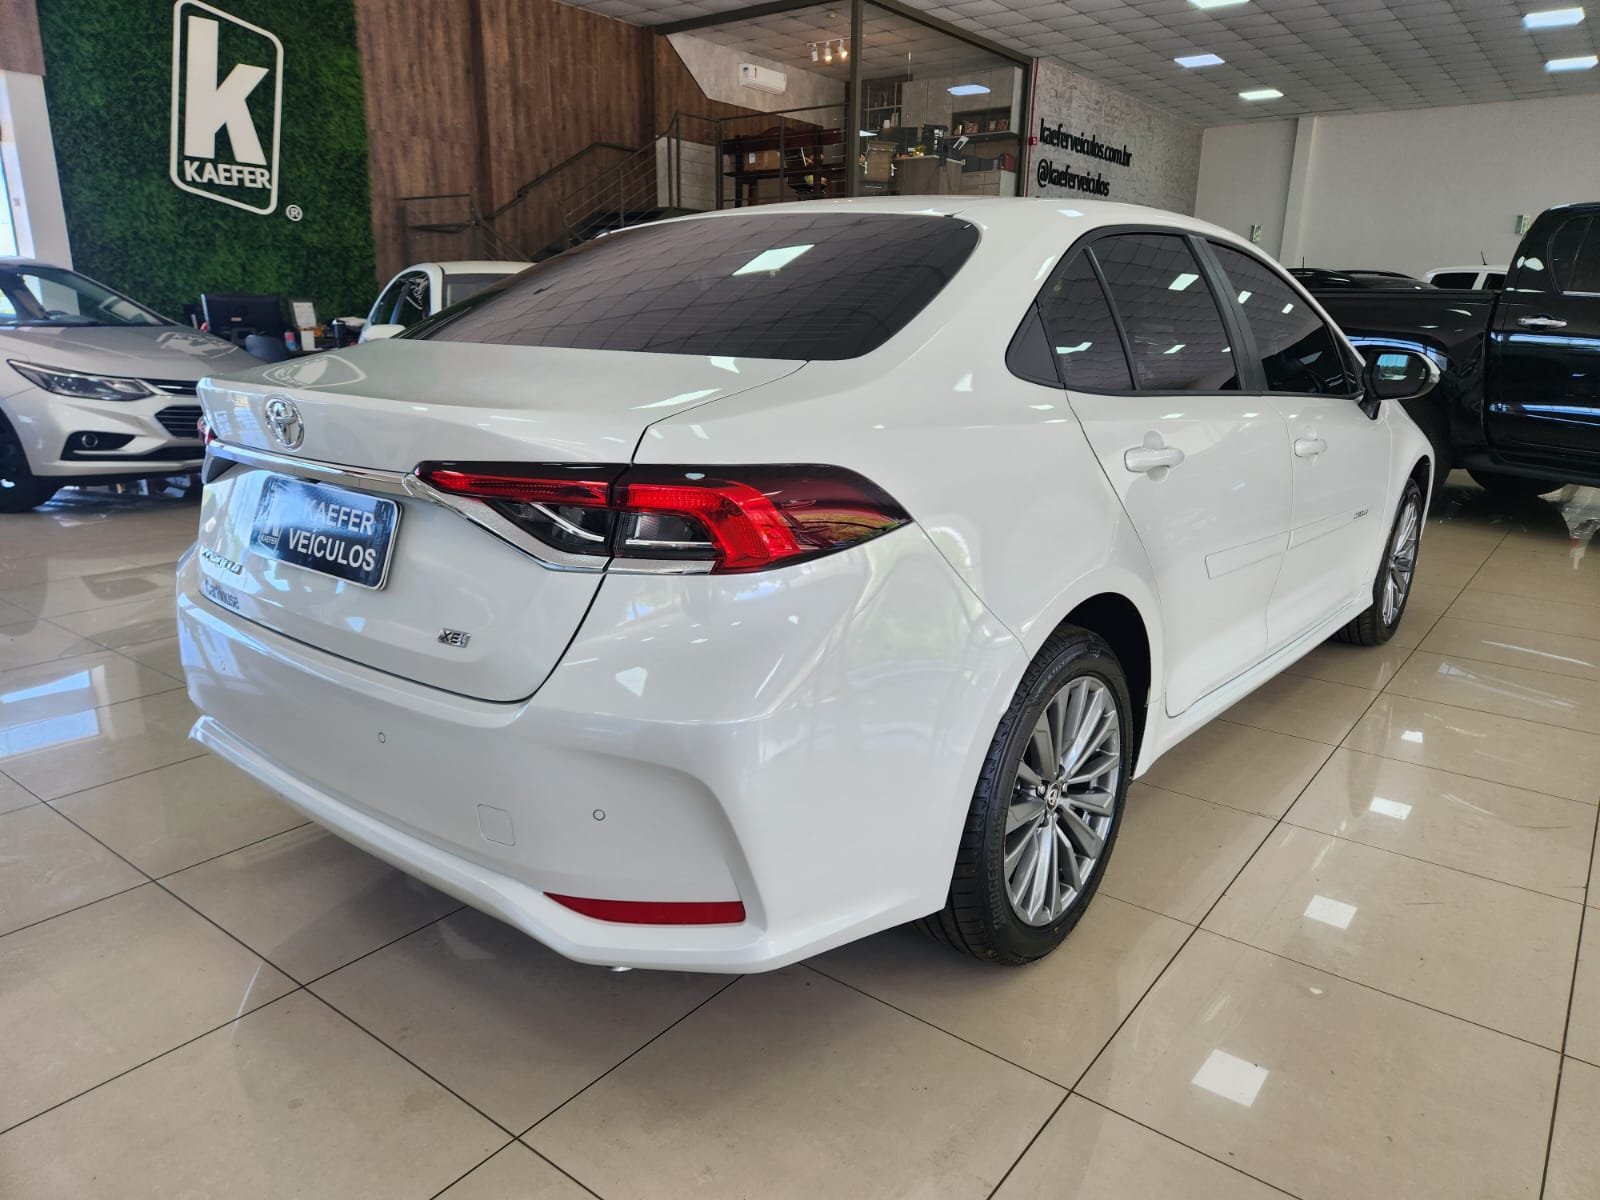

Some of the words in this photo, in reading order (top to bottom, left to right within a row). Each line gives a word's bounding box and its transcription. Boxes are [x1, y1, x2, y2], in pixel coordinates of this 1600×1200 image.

[1040, 117, 1132, 167] kaeferveiculos.com.br
[183, 159, 272, 190] KAEFER
[1037, 158, 1110, 197] @kaeferveiculos
[303, 499, 375, 536] KAEFER
